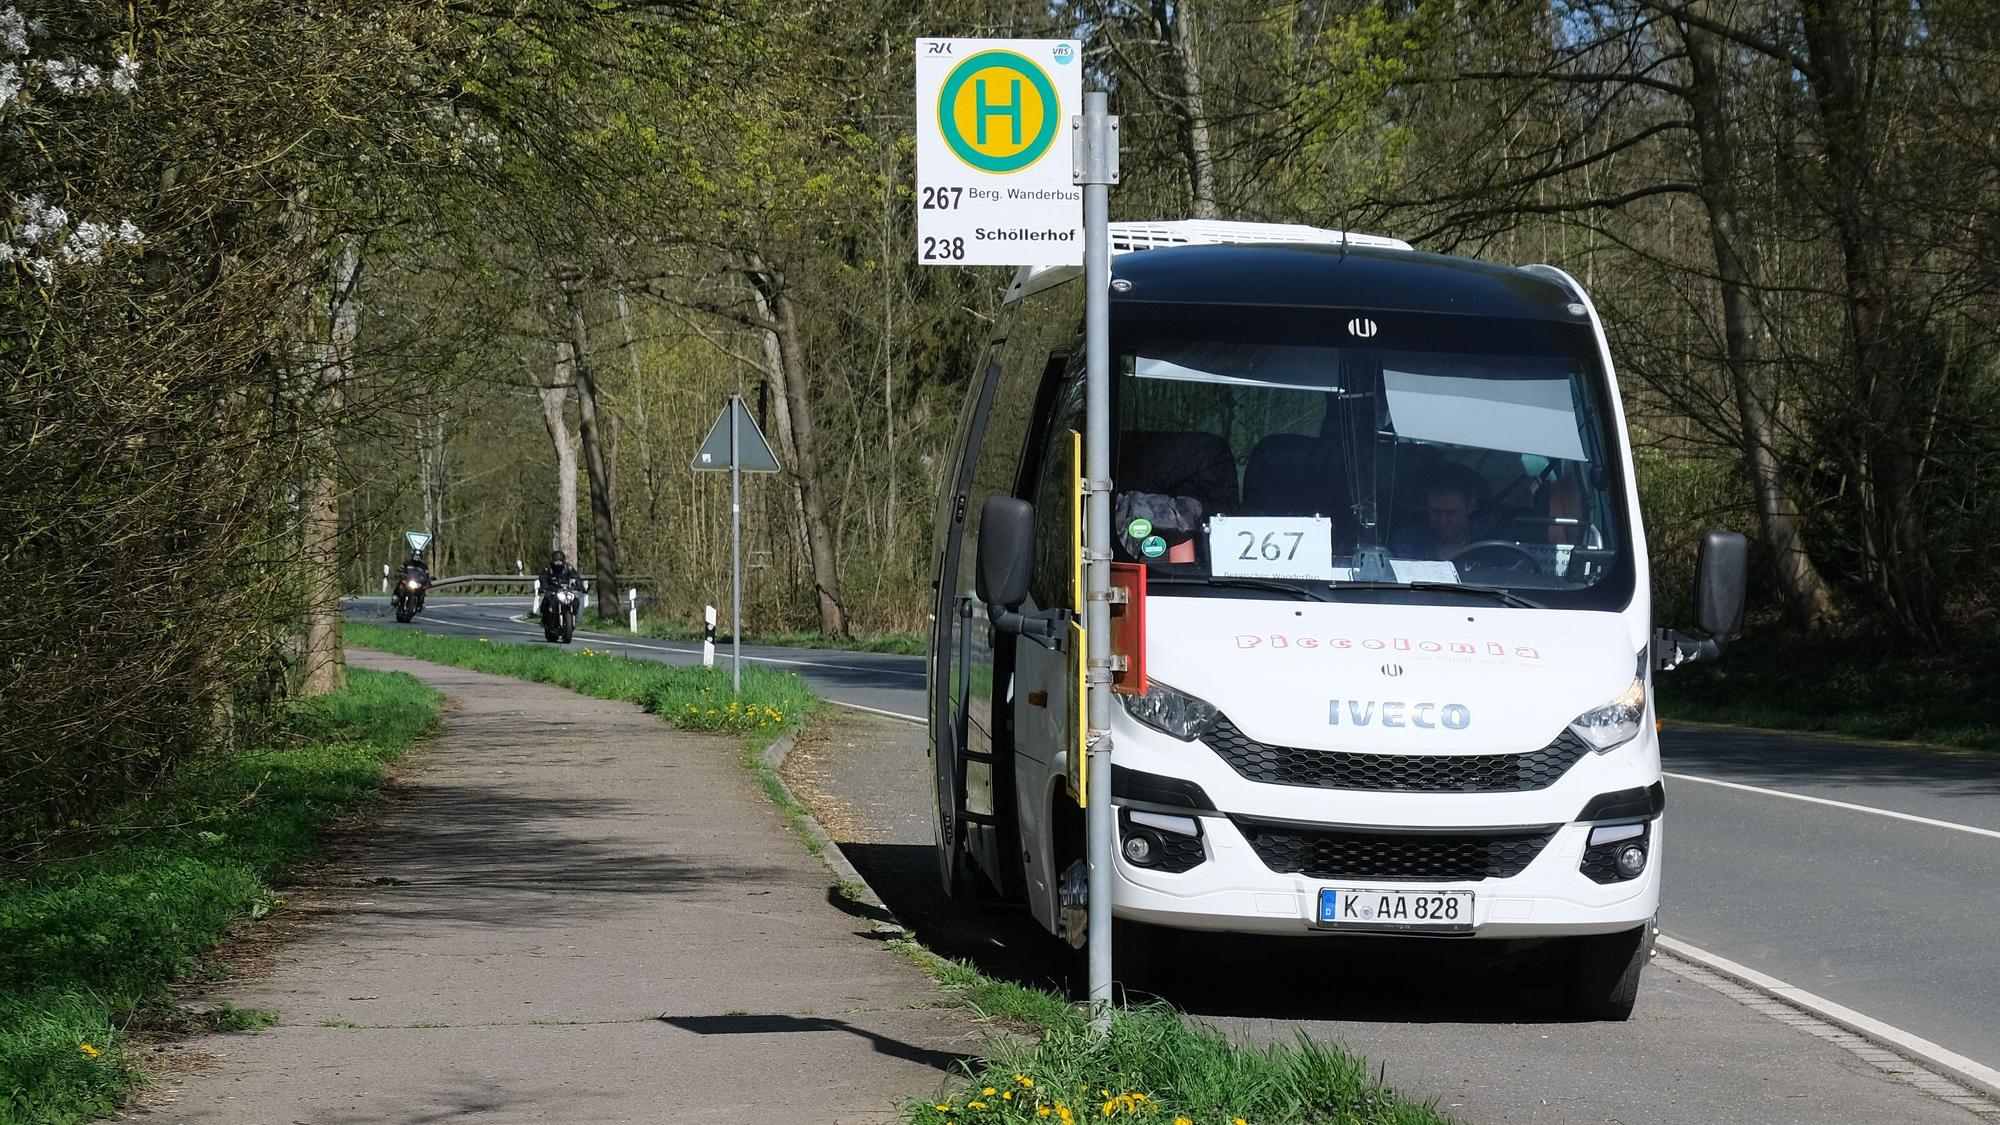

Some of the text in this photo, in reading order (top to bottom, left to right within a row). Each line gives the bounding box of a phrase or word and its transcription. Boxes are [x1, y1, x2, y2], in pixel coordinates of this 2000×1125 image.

[1052, 47, 1069, 55] VRS
[976, 79, 1022, 145] H
[922, 186, 1080, 210] 267 Berg. Wanderbus
[975, 227, 1076, 242] Schöllerhof
[923, 236, 965, 260] 238
[1237, 530, 1304, 561] 267
[1329, 700, 1471, 729] IVECO
[1344, 895, 1359, 918] K
[1377, 896, 1408, 919] AA
[1415, 897, 1459, 919] 828
